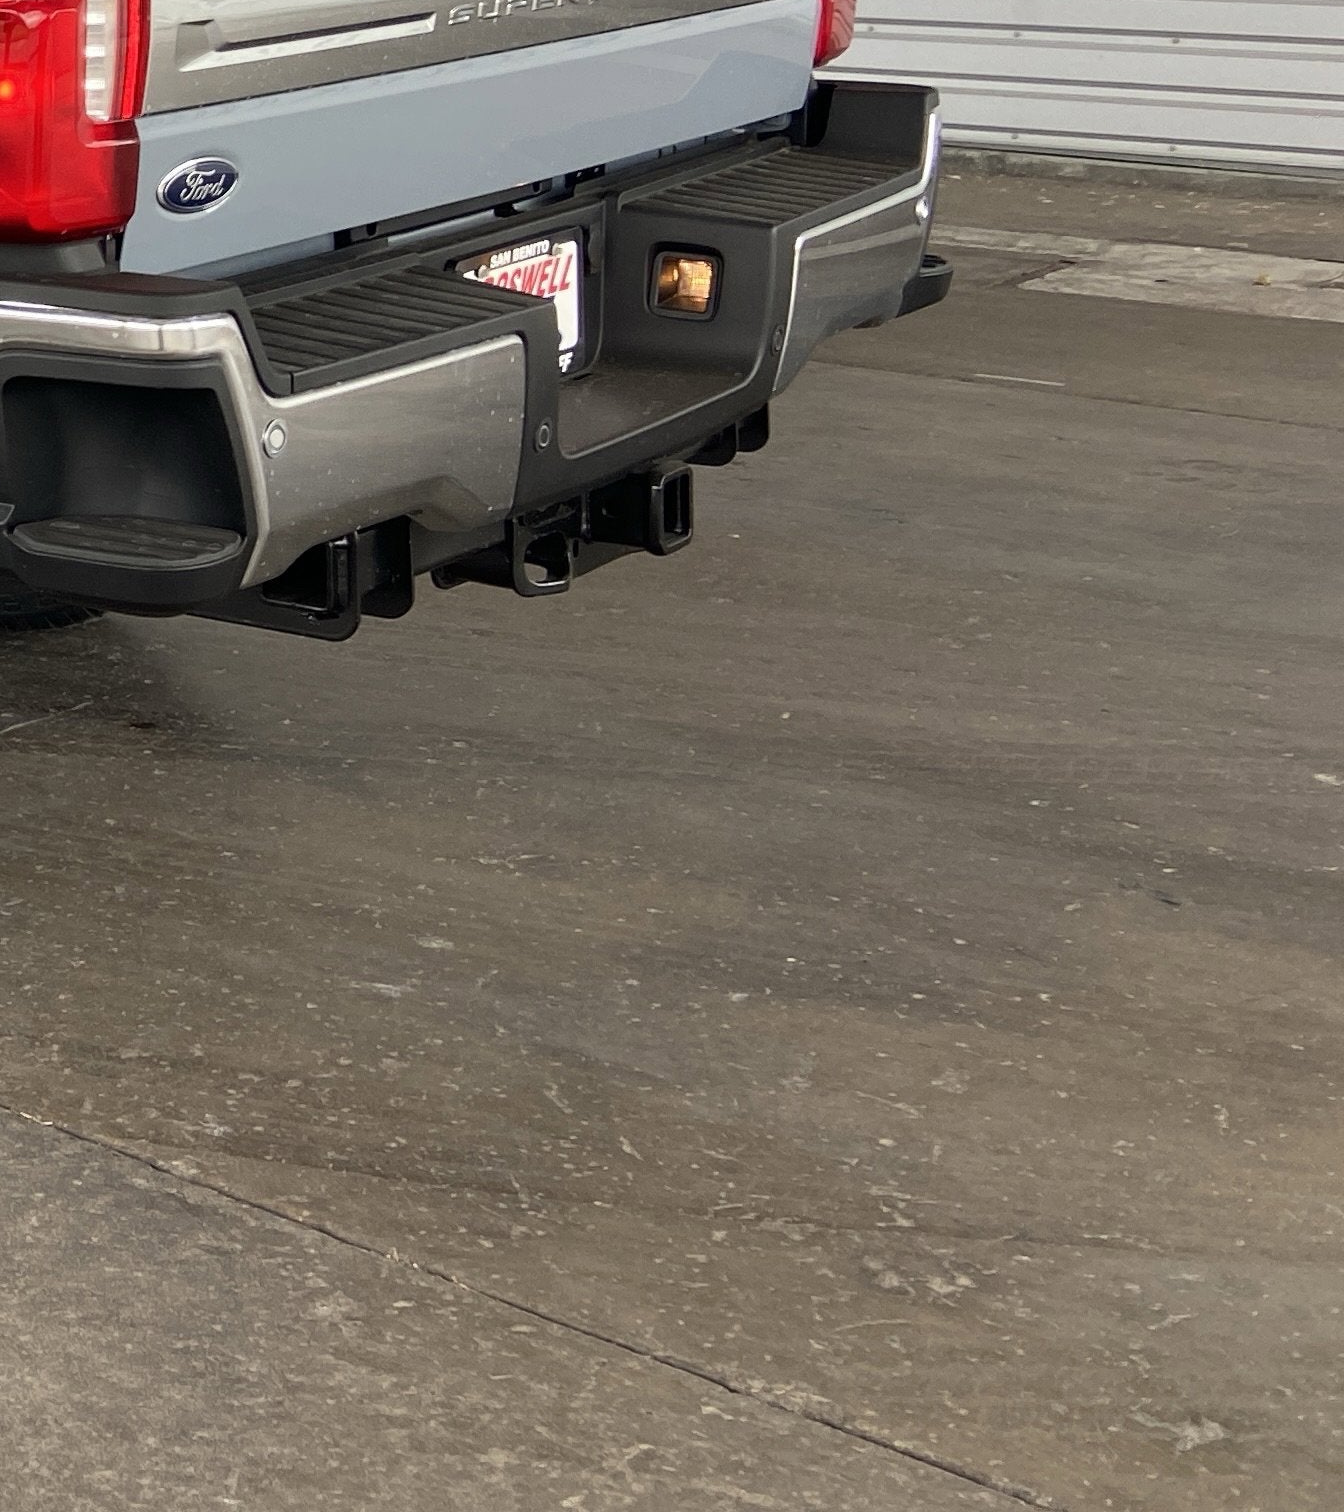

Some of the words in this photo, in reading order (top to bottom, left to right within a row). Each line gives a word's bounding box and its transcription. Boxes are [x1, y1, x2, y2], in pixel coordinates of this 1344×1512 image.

[179, 168, 227, 203] Ford
[489, 250, 513, 269] SAN
[512, 239, 551, 263] BENITO
